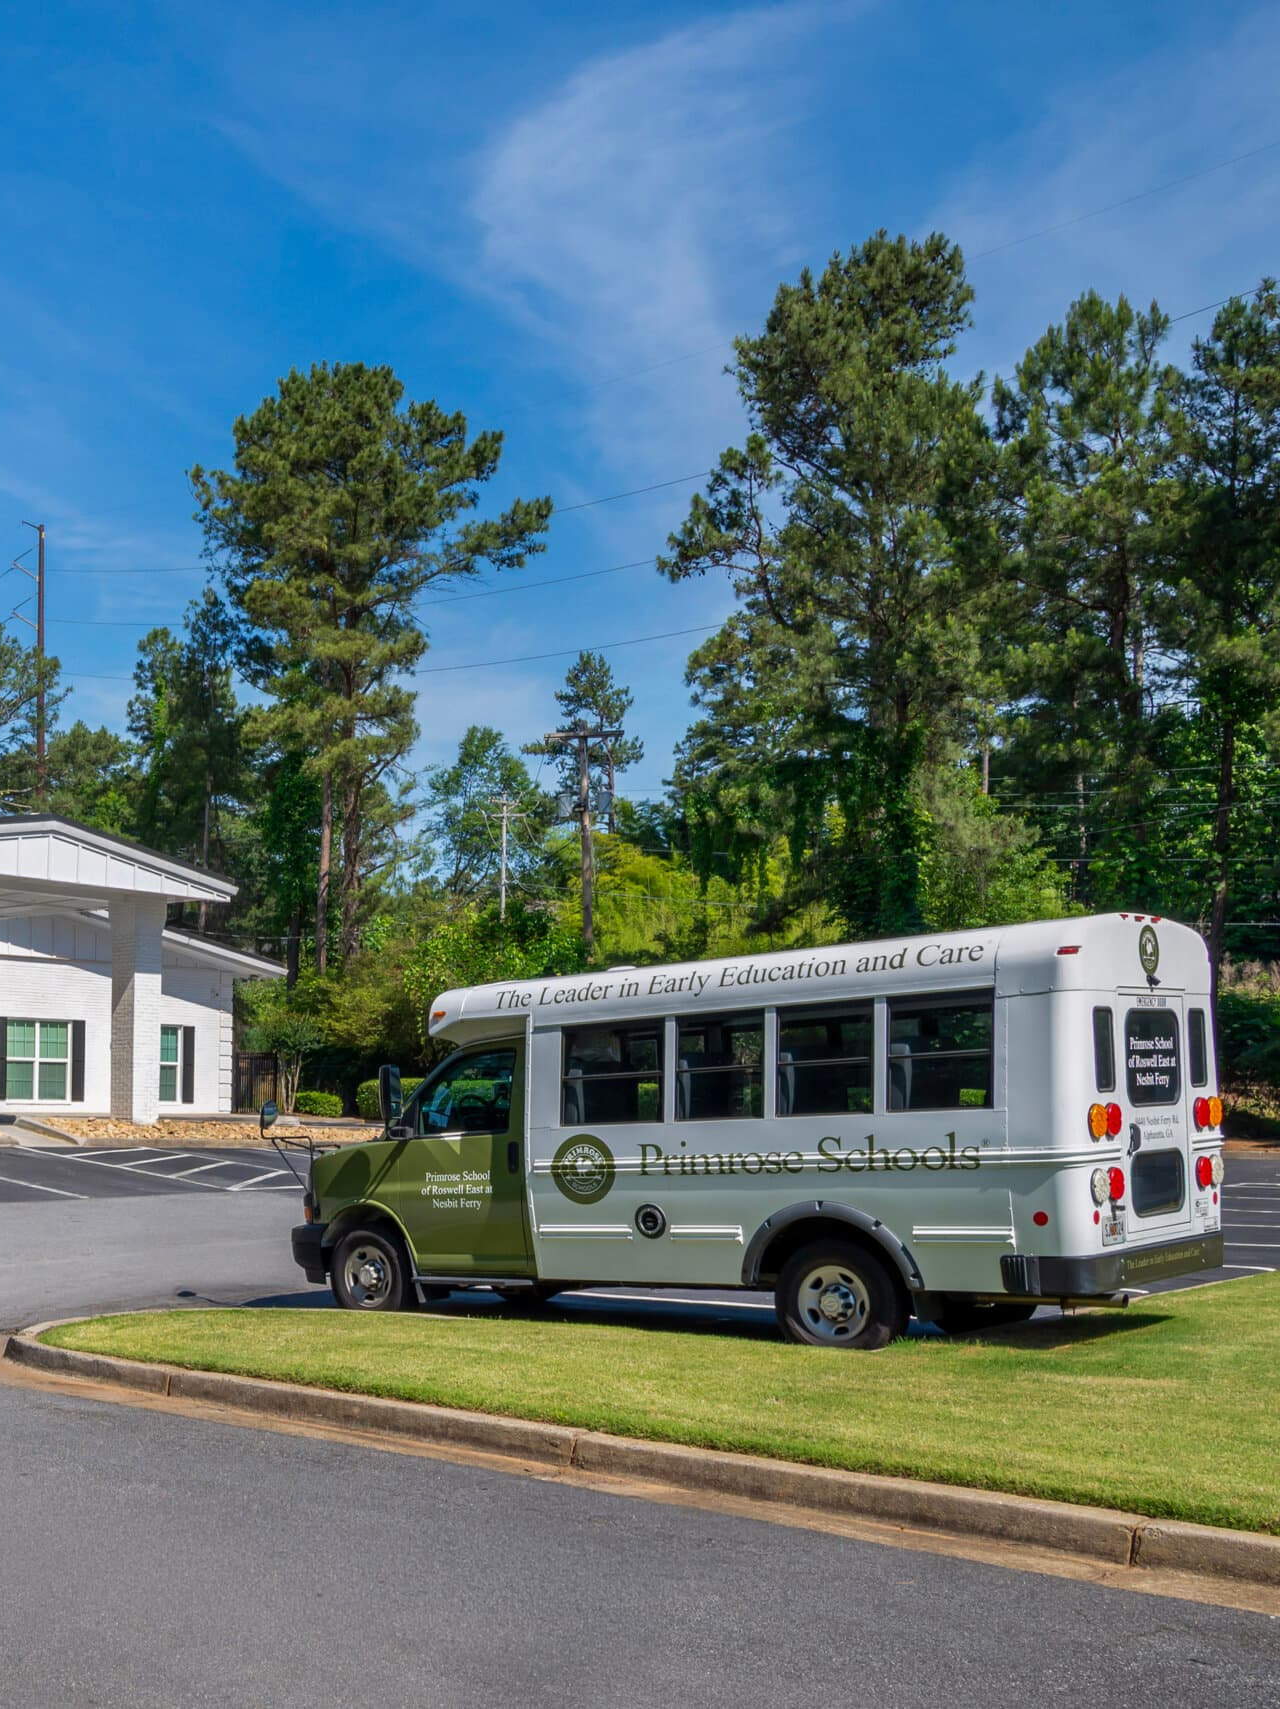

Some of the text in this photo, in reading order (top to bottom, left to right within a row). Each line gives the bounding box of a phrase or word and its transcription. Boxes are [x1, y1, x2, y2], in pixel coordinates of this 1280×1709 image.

[496, 944, 985, 1009] The Leader in Early Education and Care
[1129, 1036, 1173, 1050] Primrose School
[1128, 1054, 1176, 1068] of Roswell East at
[1154, 1072, 1170, 1087] Ferry
[638, 1140, 804, 1176] Primrose
[425, 1170, 490, 1182] Primrose School
[421, 1184, 493, 1195] of Roswell East at
[433, 1198, 481, 1210] Nesbit Ferry
